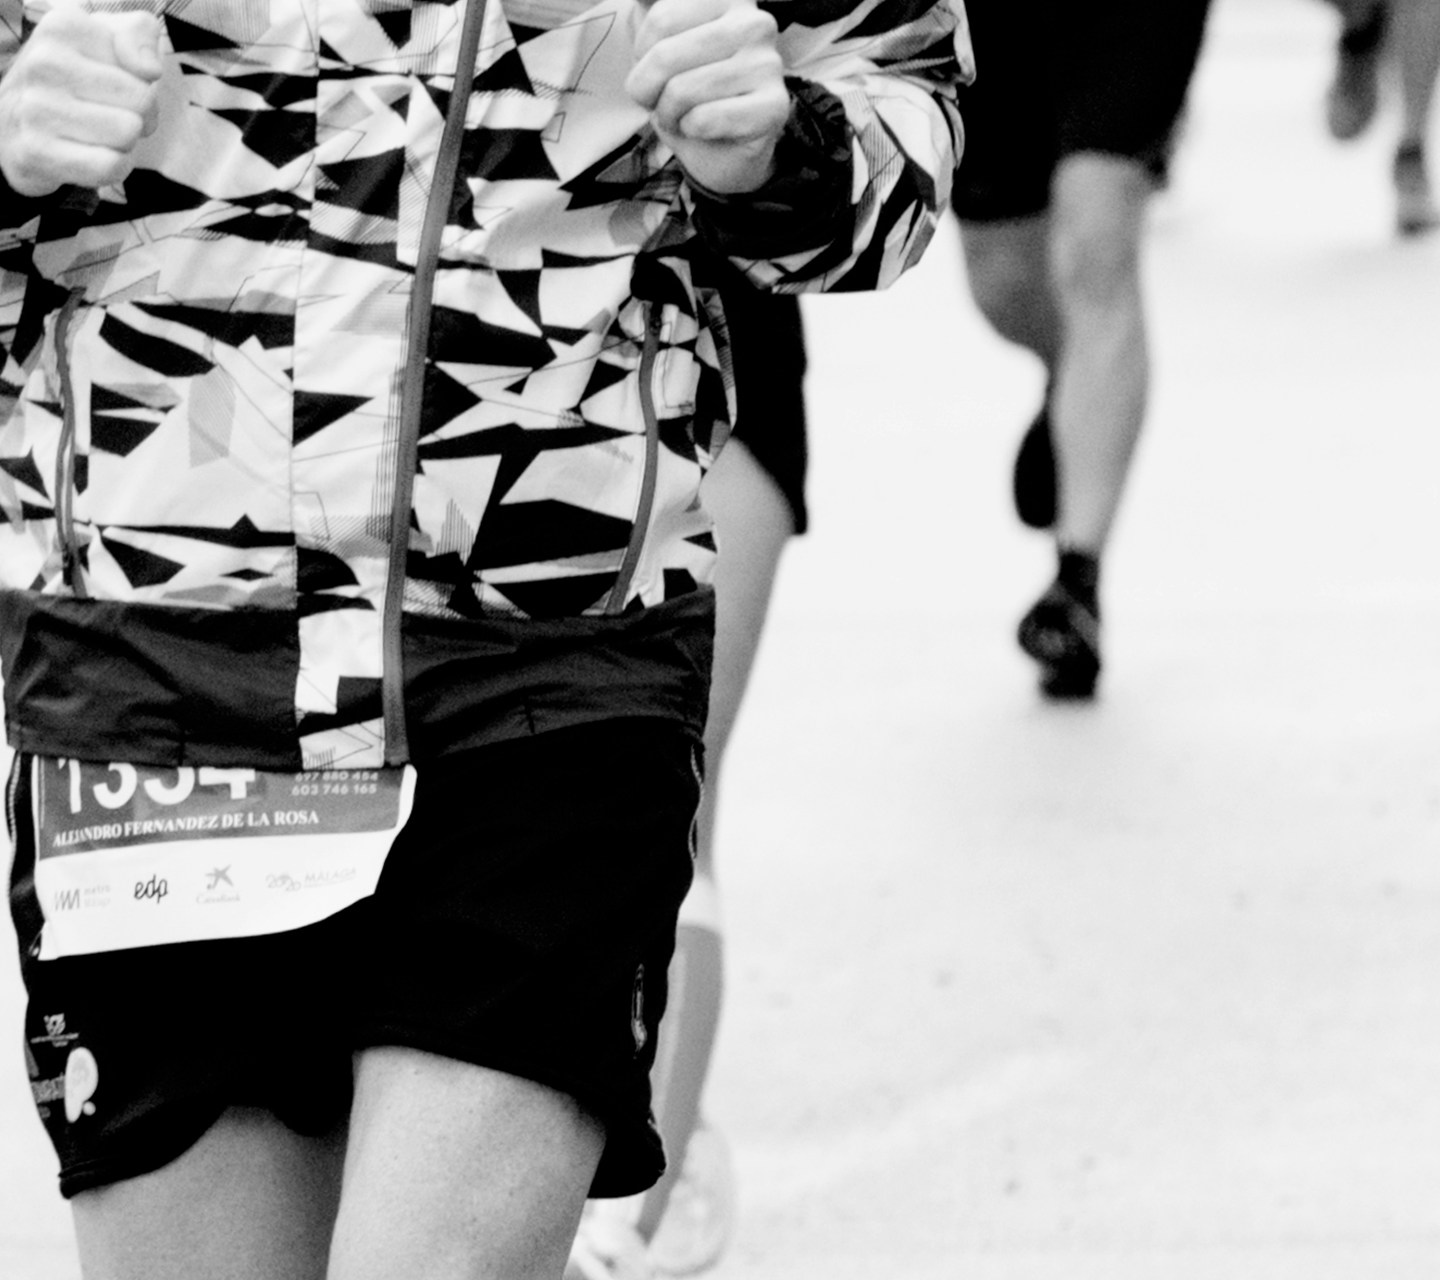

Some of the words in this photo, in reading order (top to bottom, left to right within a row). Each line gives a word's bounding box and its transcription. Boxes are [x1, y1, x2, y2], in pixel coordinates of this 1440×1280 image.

[291, 783, 319, 796] 603
[322, 783, 349, 795] 746
[353, 783, 378, 795] 165
[52, 822, 122, 848] ALEJANDRO
[124, 812, 219, 837] FERNANDEZ
[221, 812, 245, 828] DE
[247, 810, 272, 827] LA
[275, 810, 320, 826] ROSA
[134, 873, 169, 903] edp
